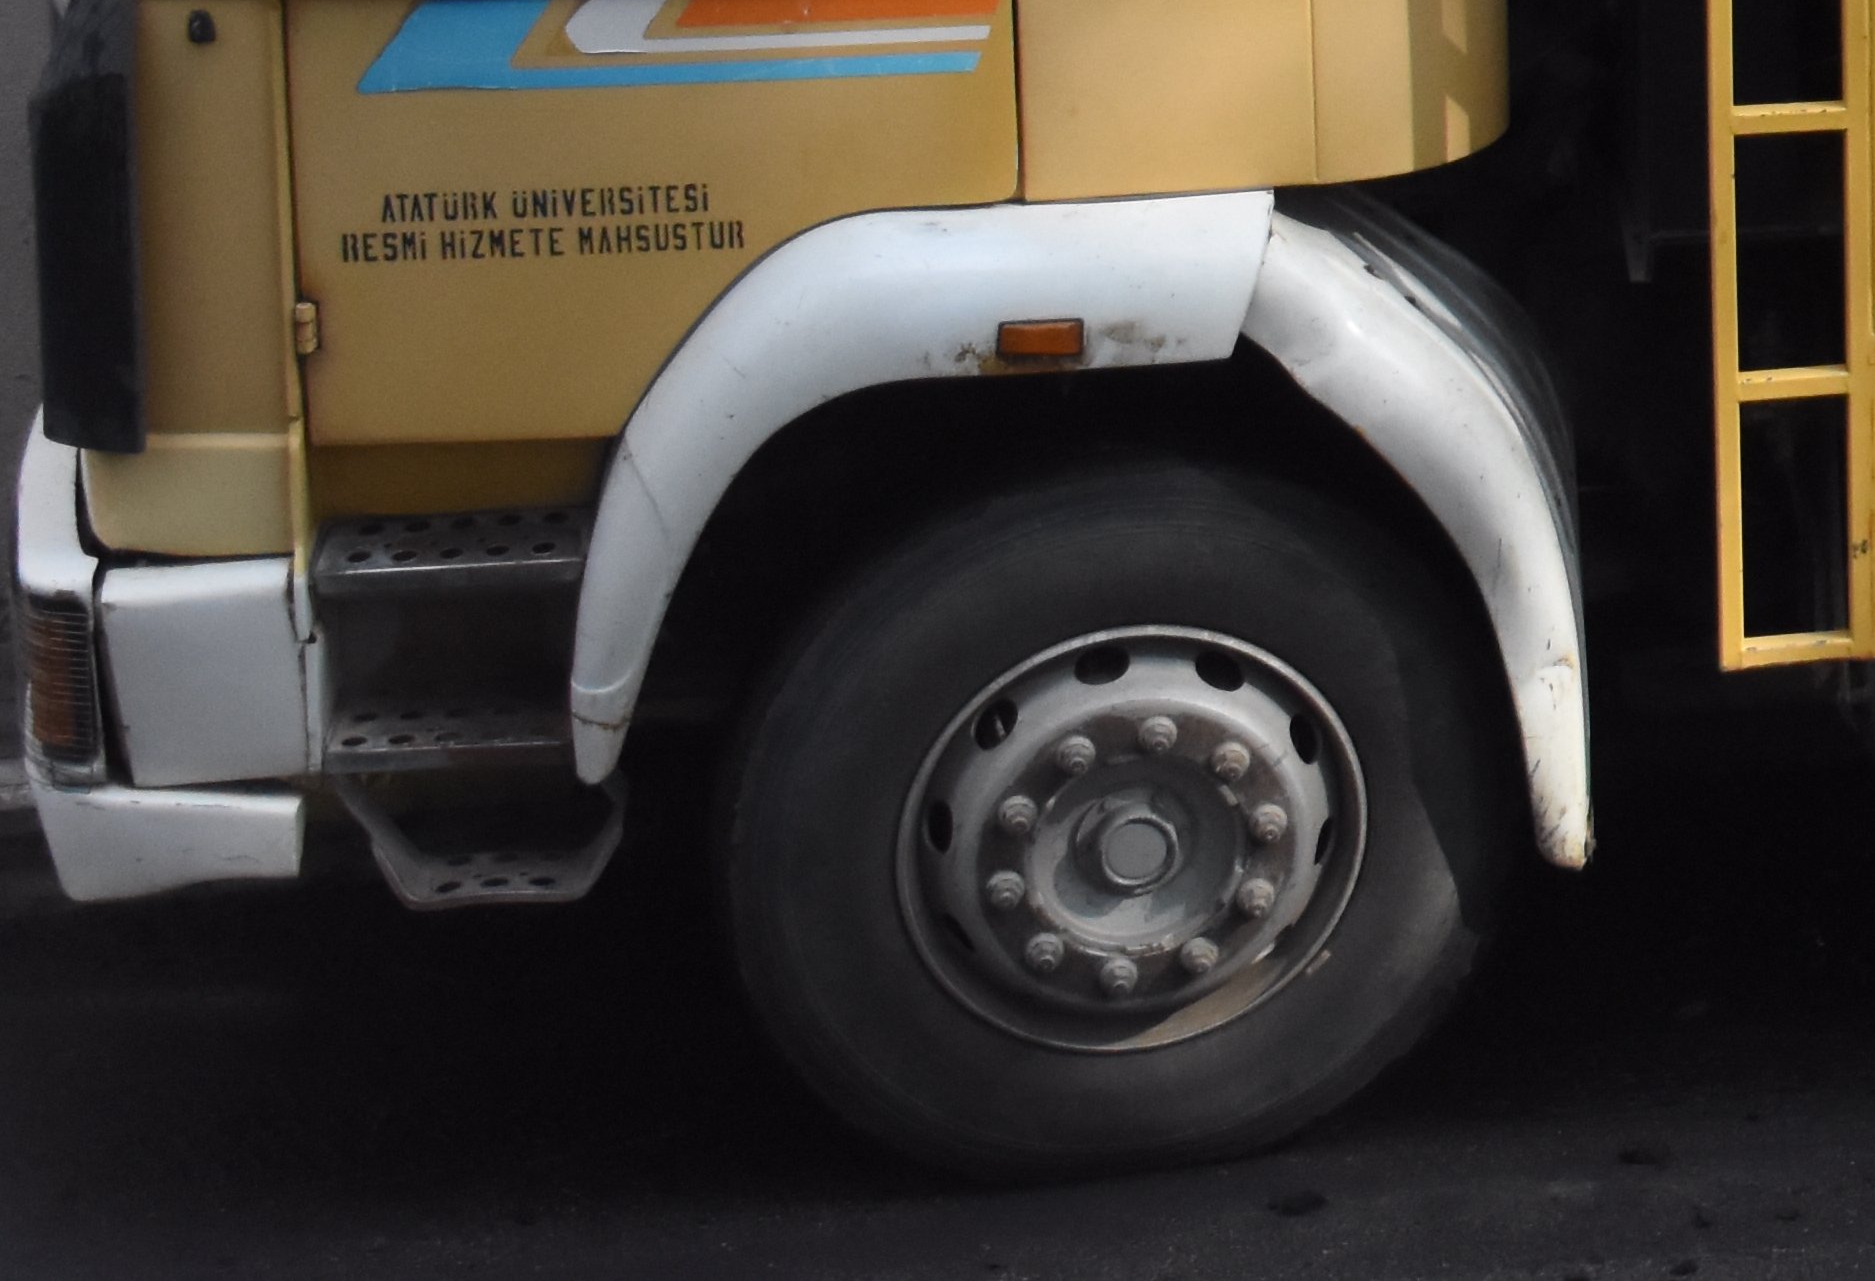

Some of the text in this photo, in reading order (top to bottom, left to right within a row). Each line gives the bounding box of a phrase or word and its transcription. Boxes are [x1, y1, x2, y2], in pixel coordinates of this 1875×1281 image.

[380, 182, 710, 224] ATATÜRK ÜNİVERSİTESİ
[341, 220, 746, 264] RESMİ HİZMETE MAHSUSTUR
